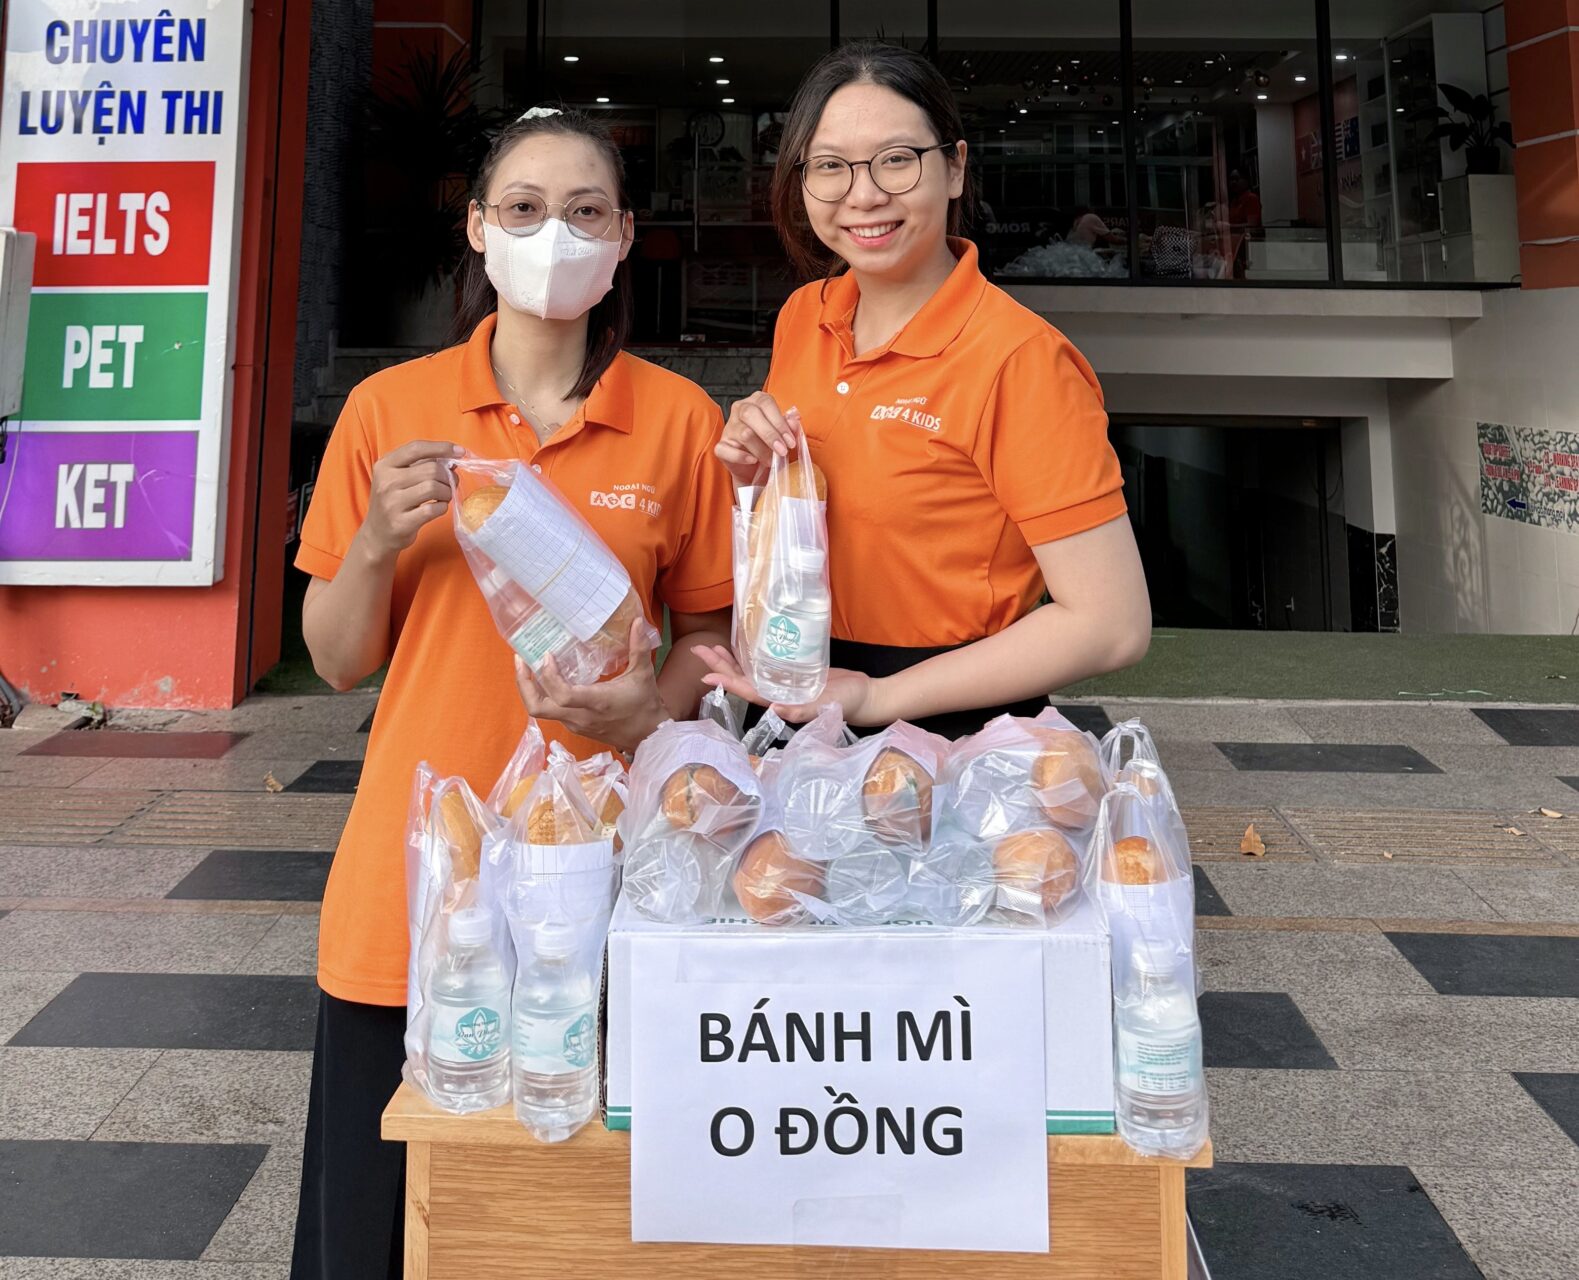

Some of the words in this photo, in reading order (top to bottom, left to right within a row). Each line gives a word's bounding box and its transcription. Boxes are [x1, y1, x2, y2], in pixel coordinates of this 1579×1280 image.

[45, 8, 207, 65] CHUYÊN
[18, 80, 147, 146] LUYỆN
[161, 89, 224, 136] THI
[52, 190, 171, 257] IELTS
[62, 324, 145, 390] PET
[911, 410, 942, 431] KIDS
[55, 463, 135, 530] KET
[591, 491, 635, 509] ABC
[698, 997, 875, 1064] BÁNH
[897, 993, 974, 1063] MÌ
[774, 1085, 965, 1158] ĐỒNG
